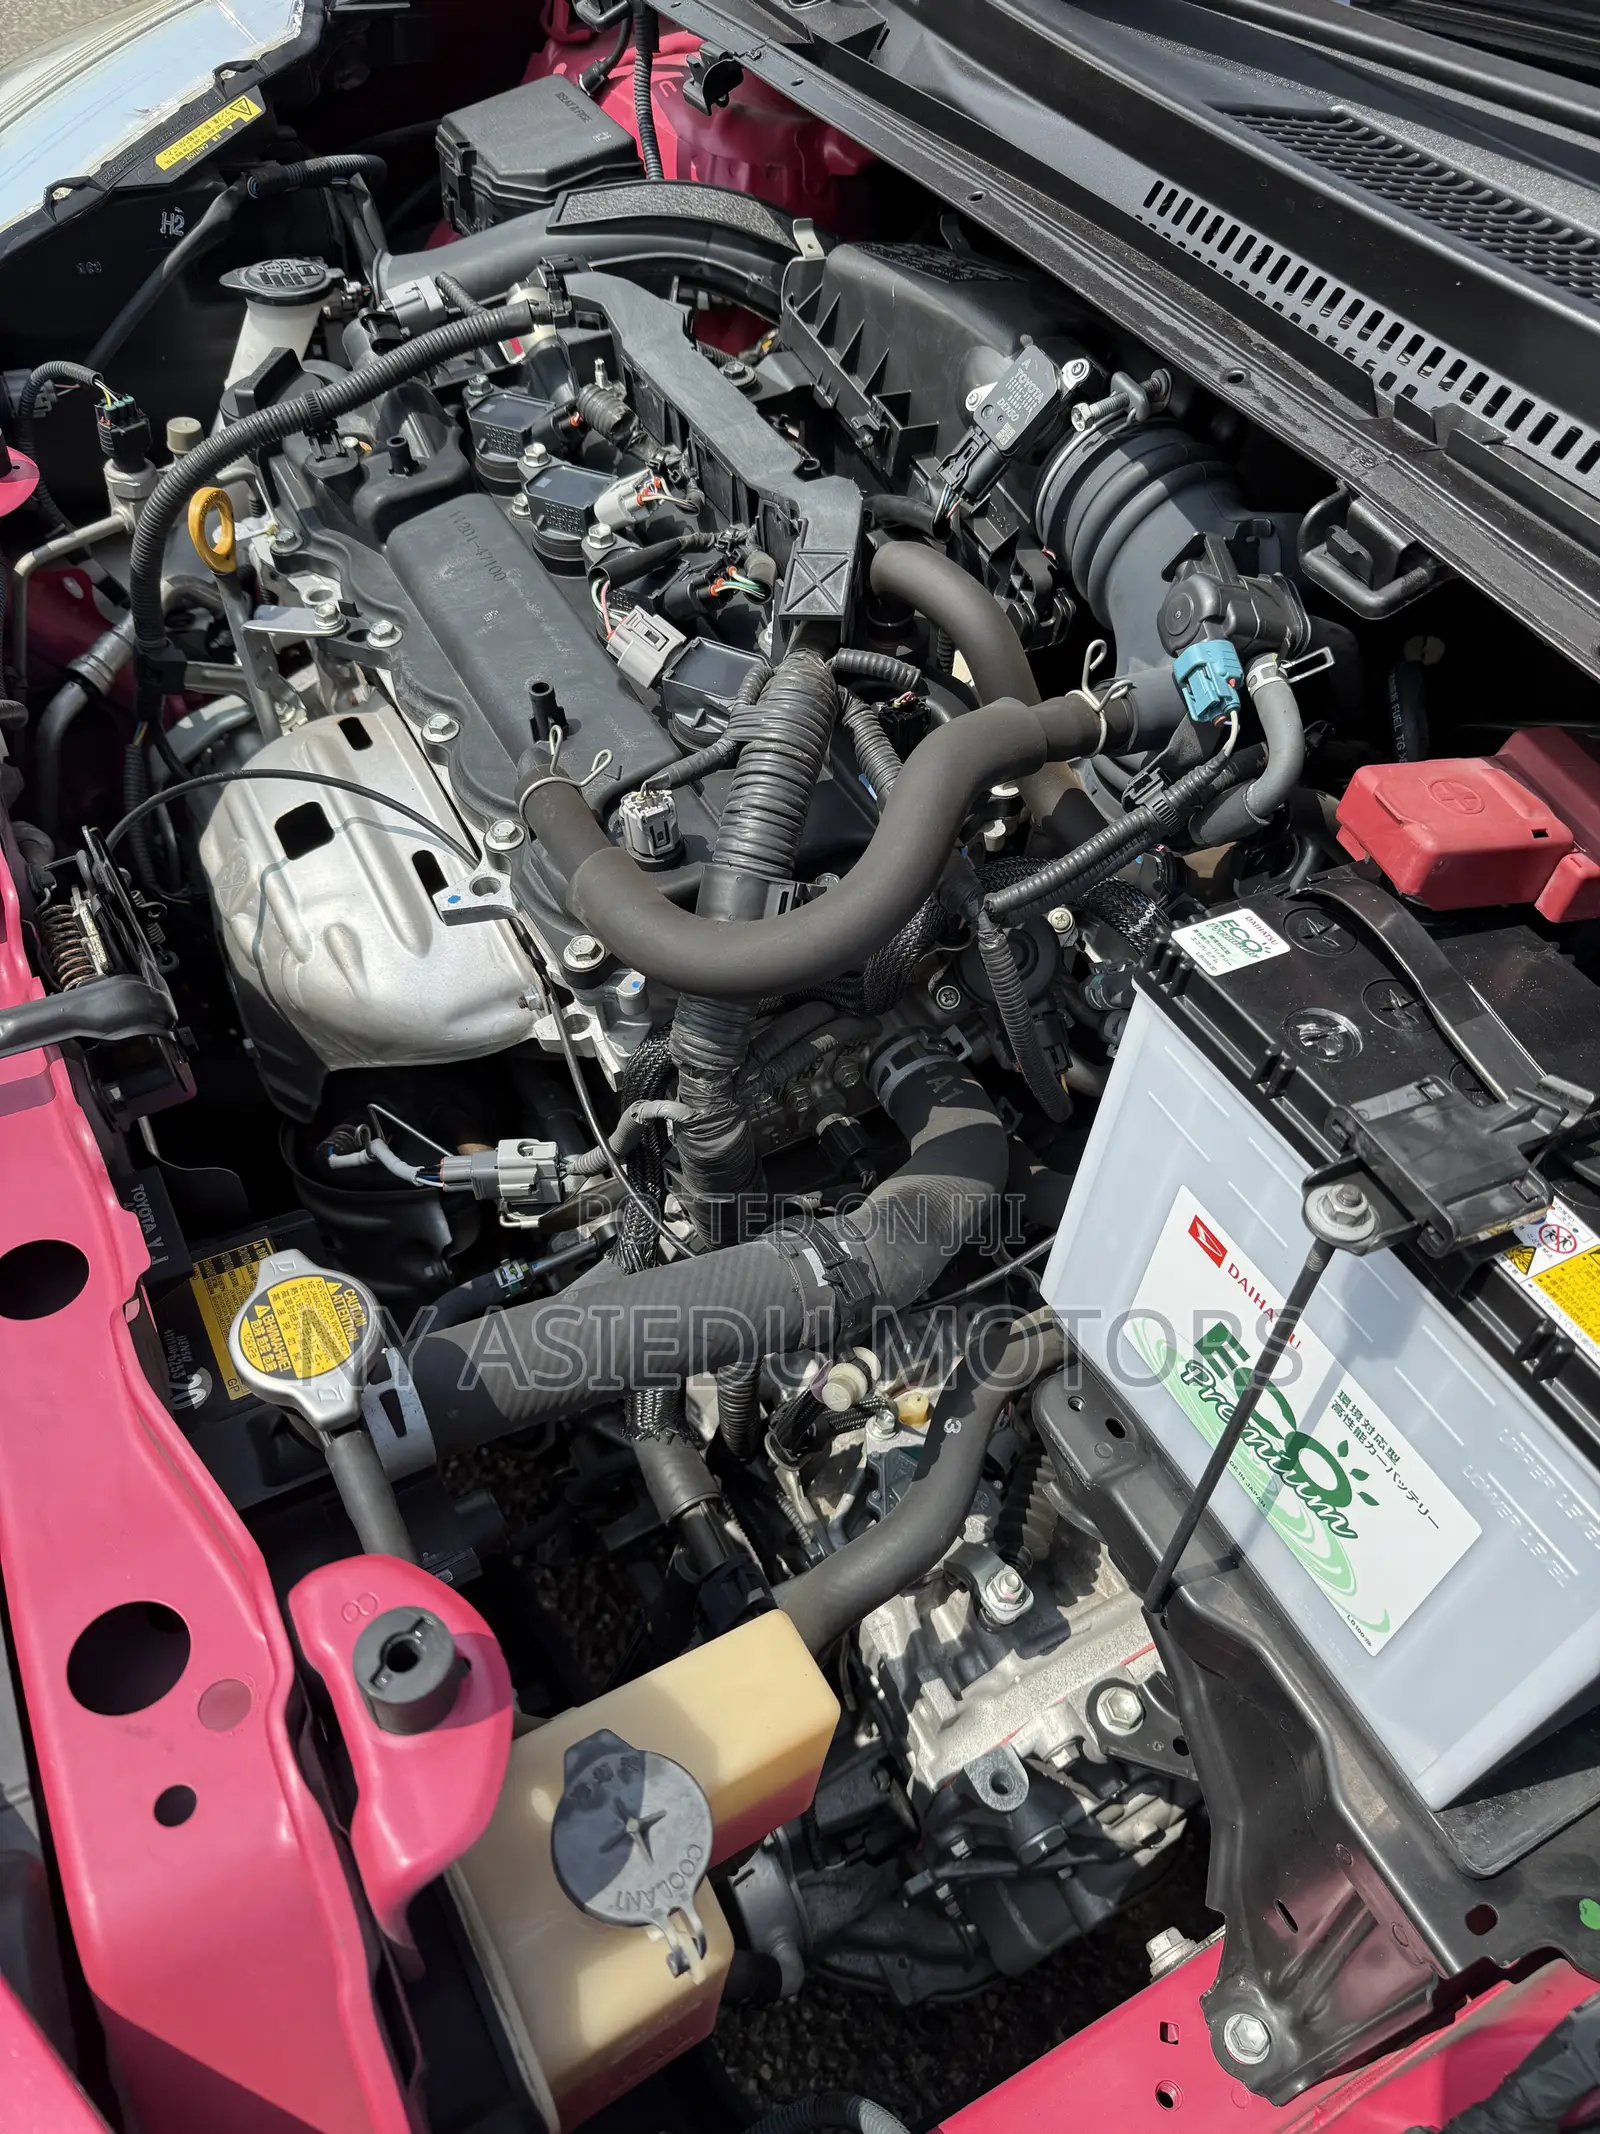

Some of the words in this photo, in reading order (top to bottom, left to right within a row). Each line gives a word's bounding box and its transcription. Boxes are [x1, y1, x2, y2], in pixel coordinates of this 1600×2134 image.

[185, 142, 208, 161] CAUTION
[997, 398, 1020, 421] DENSO
[1014, 368, 1043, 403] TOYOTA
[449, 510, 506, 583] 11201-47100
[1391, 703, 1402, 731] FUEL
[1395, 733, 1405, 750] TG
[1218, 919, 1263, 953] ECO
[131, 1183, 156, 1234] TOYOTA
[315, 1280, 328, 1300] NEVER
[323, 1301, 335, 1319] OPEN
[331, 1320, 343, 1340] WHEN
[331, 1293, 358, 1342] ATTENTION
[343, 1288, 367, 1327] CAUTION
[1228, 1263, 1302, 1349] DAIHAU
[176, 1334, 193, 1363] DENSO
[262, 1314, 291, 1372] ВНИМАНИЕ!
[226, 1377, 240, 1393] GP
[1193, 1320, 1349, 1504] ECO
[1336, 1389, 1401, 1466] 環境対応型
[1182, 1357, 1359, 1537] Premium
[1330, 1399, 1440, 1531] 高性能カーバッテリー
[1245, 1481, 1266, 1507] JAPAN
[609, 1843, 701, 1911] COOLANT
